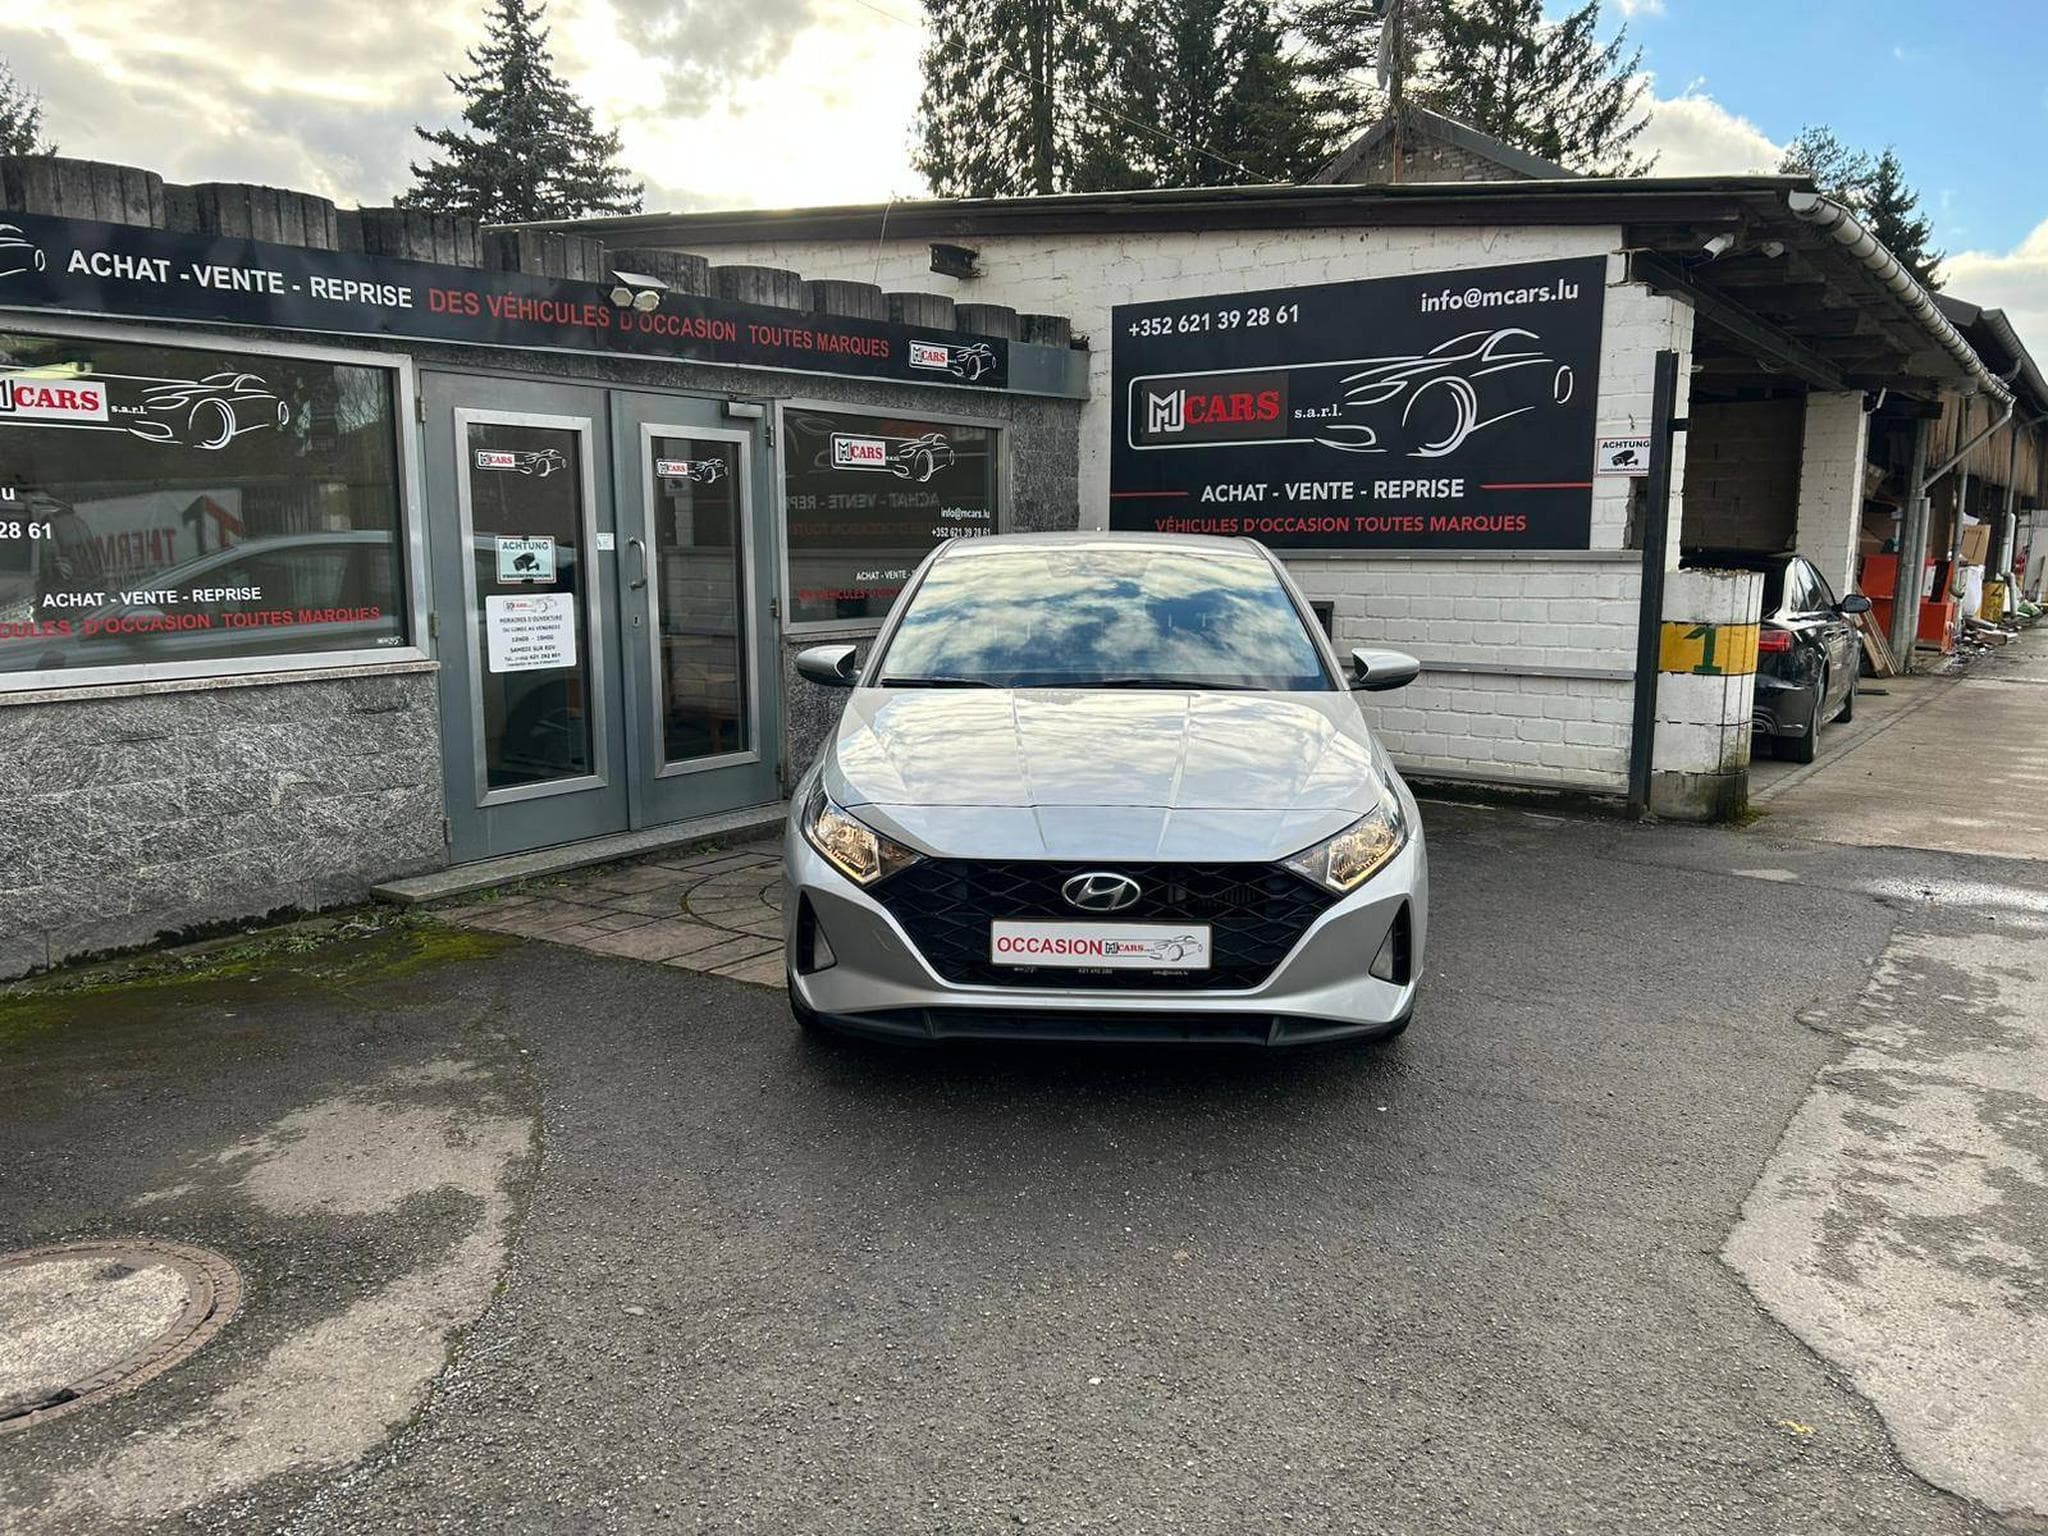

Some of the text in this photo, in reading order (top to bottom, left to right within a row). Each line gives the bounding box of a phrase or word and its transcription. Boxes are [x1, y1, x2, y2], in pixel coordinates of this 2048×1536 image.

[67, 249, 170, 283] ACHAT
[311, 276, 412, 308] REPRISE
[428, 288, 480, 315] DES
[486, 291, 610, 329] VÉHICULES
[620, 311, 736, 342] DOCCASION
[749, 325, 812, 349] TOUTES
[817, 332, 889, 358] MARQUES
[1421, 278, 1579, 312] info@mcars.lu
[1128, 304, 1299, 337] +352 621 39 28 61
[14, 386, 100, 411] CARS
[111, 405, 148, 415] s.a.r.l.
[1294, 404, 1343, 418] s.a.r.l.
[1602, 440, 1650, 449] ACHTUNG
[1201, 484, 1267, 502] ACHAT
[1285, 481, 1354, 500] VENTE
[1374, 479, 1464, 499] REPRISE
[27, 522, 52, 540] 61
[1155, 515, 1239, 534] VÉHICULES
[1355, 516, 1424, 532] TOUTES
[1430, 514, 1527, 533] MARQUES
[502, 541, 549, 551] ACHTUNG
[855, 571, 881, 581] ACHAT
[884, 569, 907, 579] VENTE
[43, 592, 105, 608] ACHAT
[120, 590, 178, 605] VENTE
[192, 586, 263, 602] REPRISE
[84, 613, 211, 636] D'OCCASION
[222, 610, 293, 629] TOUTES
[298, 606, 381, 625] MARQUES
[1683, 625, 1722, 673] 1
[996, 937, 1103, 956] OCCASION
